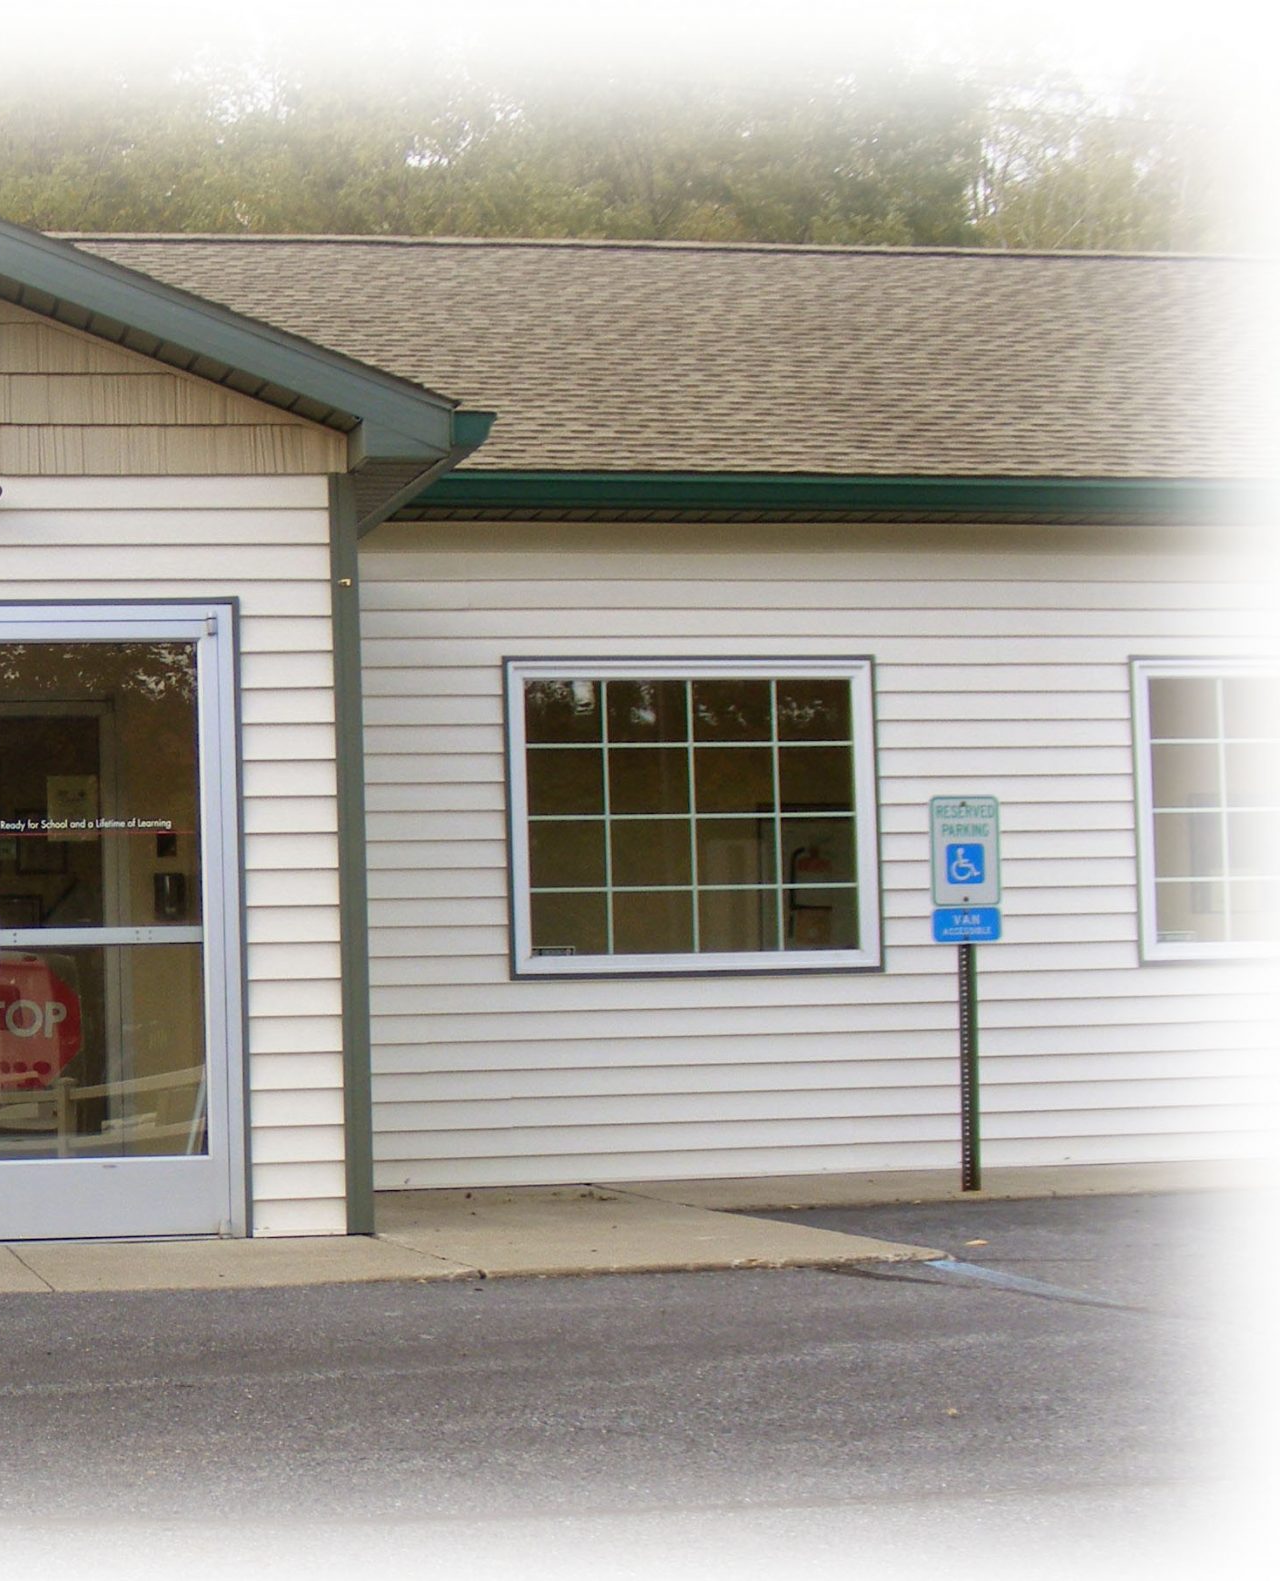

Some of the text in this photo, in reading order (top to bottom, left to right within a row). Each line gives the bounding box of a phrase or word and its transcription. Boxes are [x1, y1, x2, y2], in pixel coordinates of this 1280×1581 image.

[935, 805, 995, 819] RESERVED
[0, 820, 26, 832] Ready
[27, 819, 39, 829] for
[41, 819, 68, 829] School
[70, 819, 86, 829] and
[95, 818, 126, 829] Lifetime
[127, 818, 136, 828] of
[137, 818, 172, 829] Learning
[942, 823, 990, 837] PARKING
[952, 914, 981, 925] VAN
